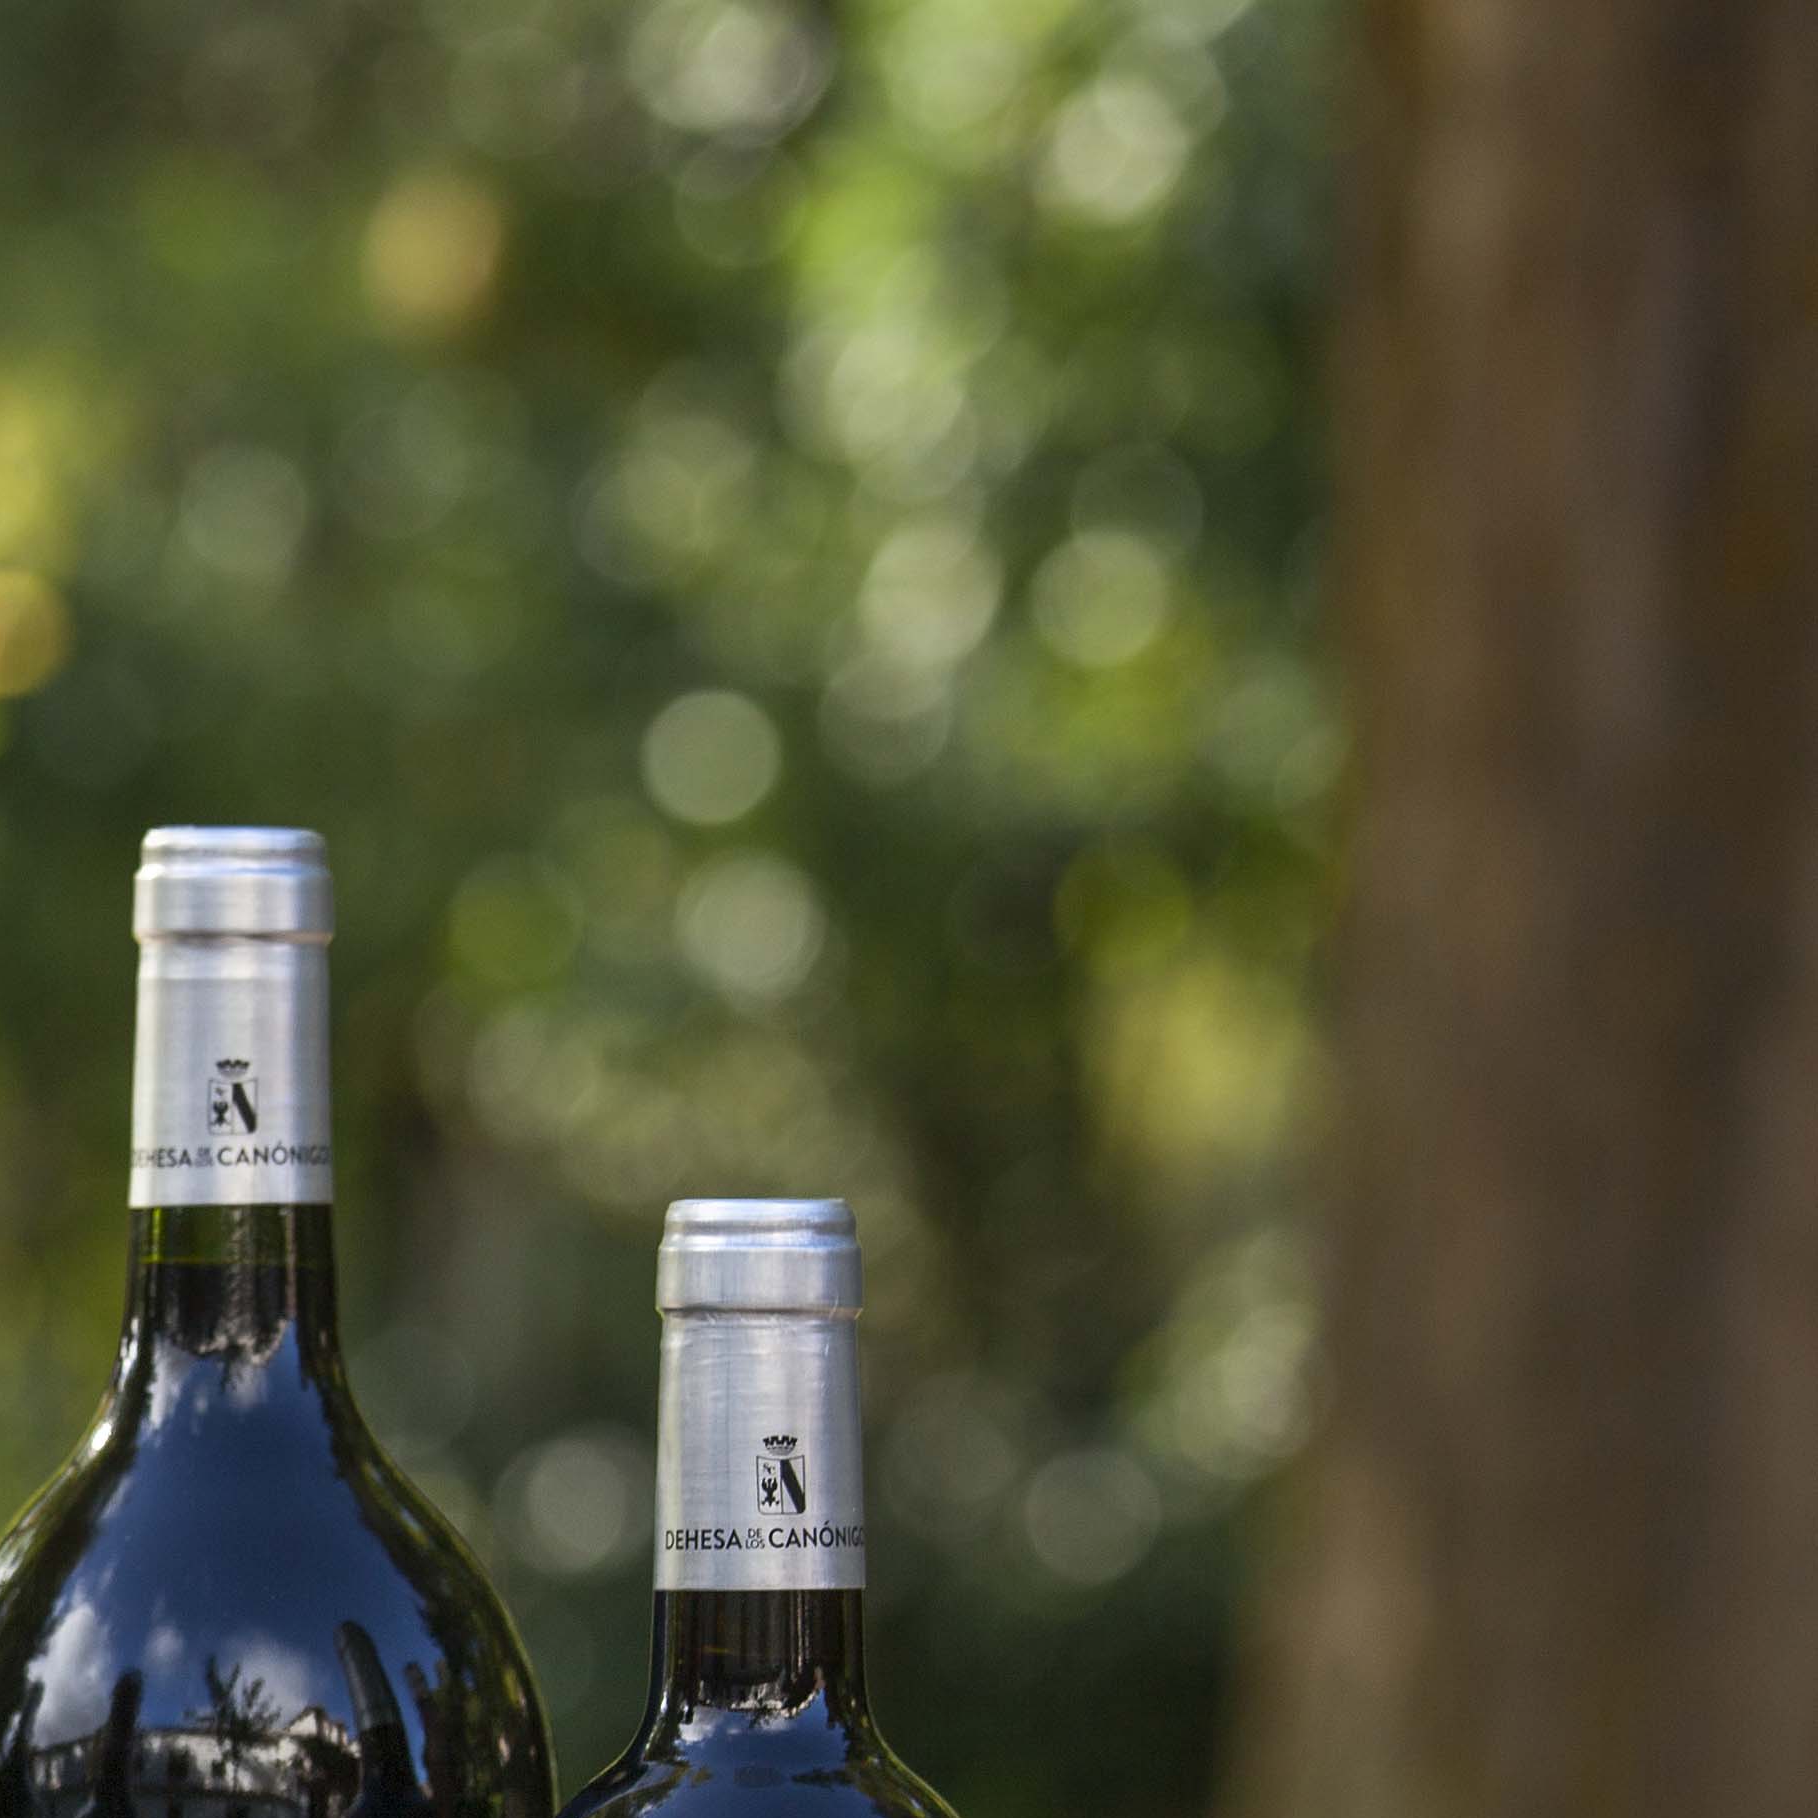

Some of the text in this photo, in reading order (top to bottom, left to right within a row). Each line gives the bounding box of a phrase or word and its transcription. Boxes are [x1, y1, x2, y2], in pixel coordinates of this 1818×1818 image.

[747, 1528, 763, 1539] DE
[665, 1529, 742, 1550] DEHESA
[745, 1539, 765, 1550] LOS
